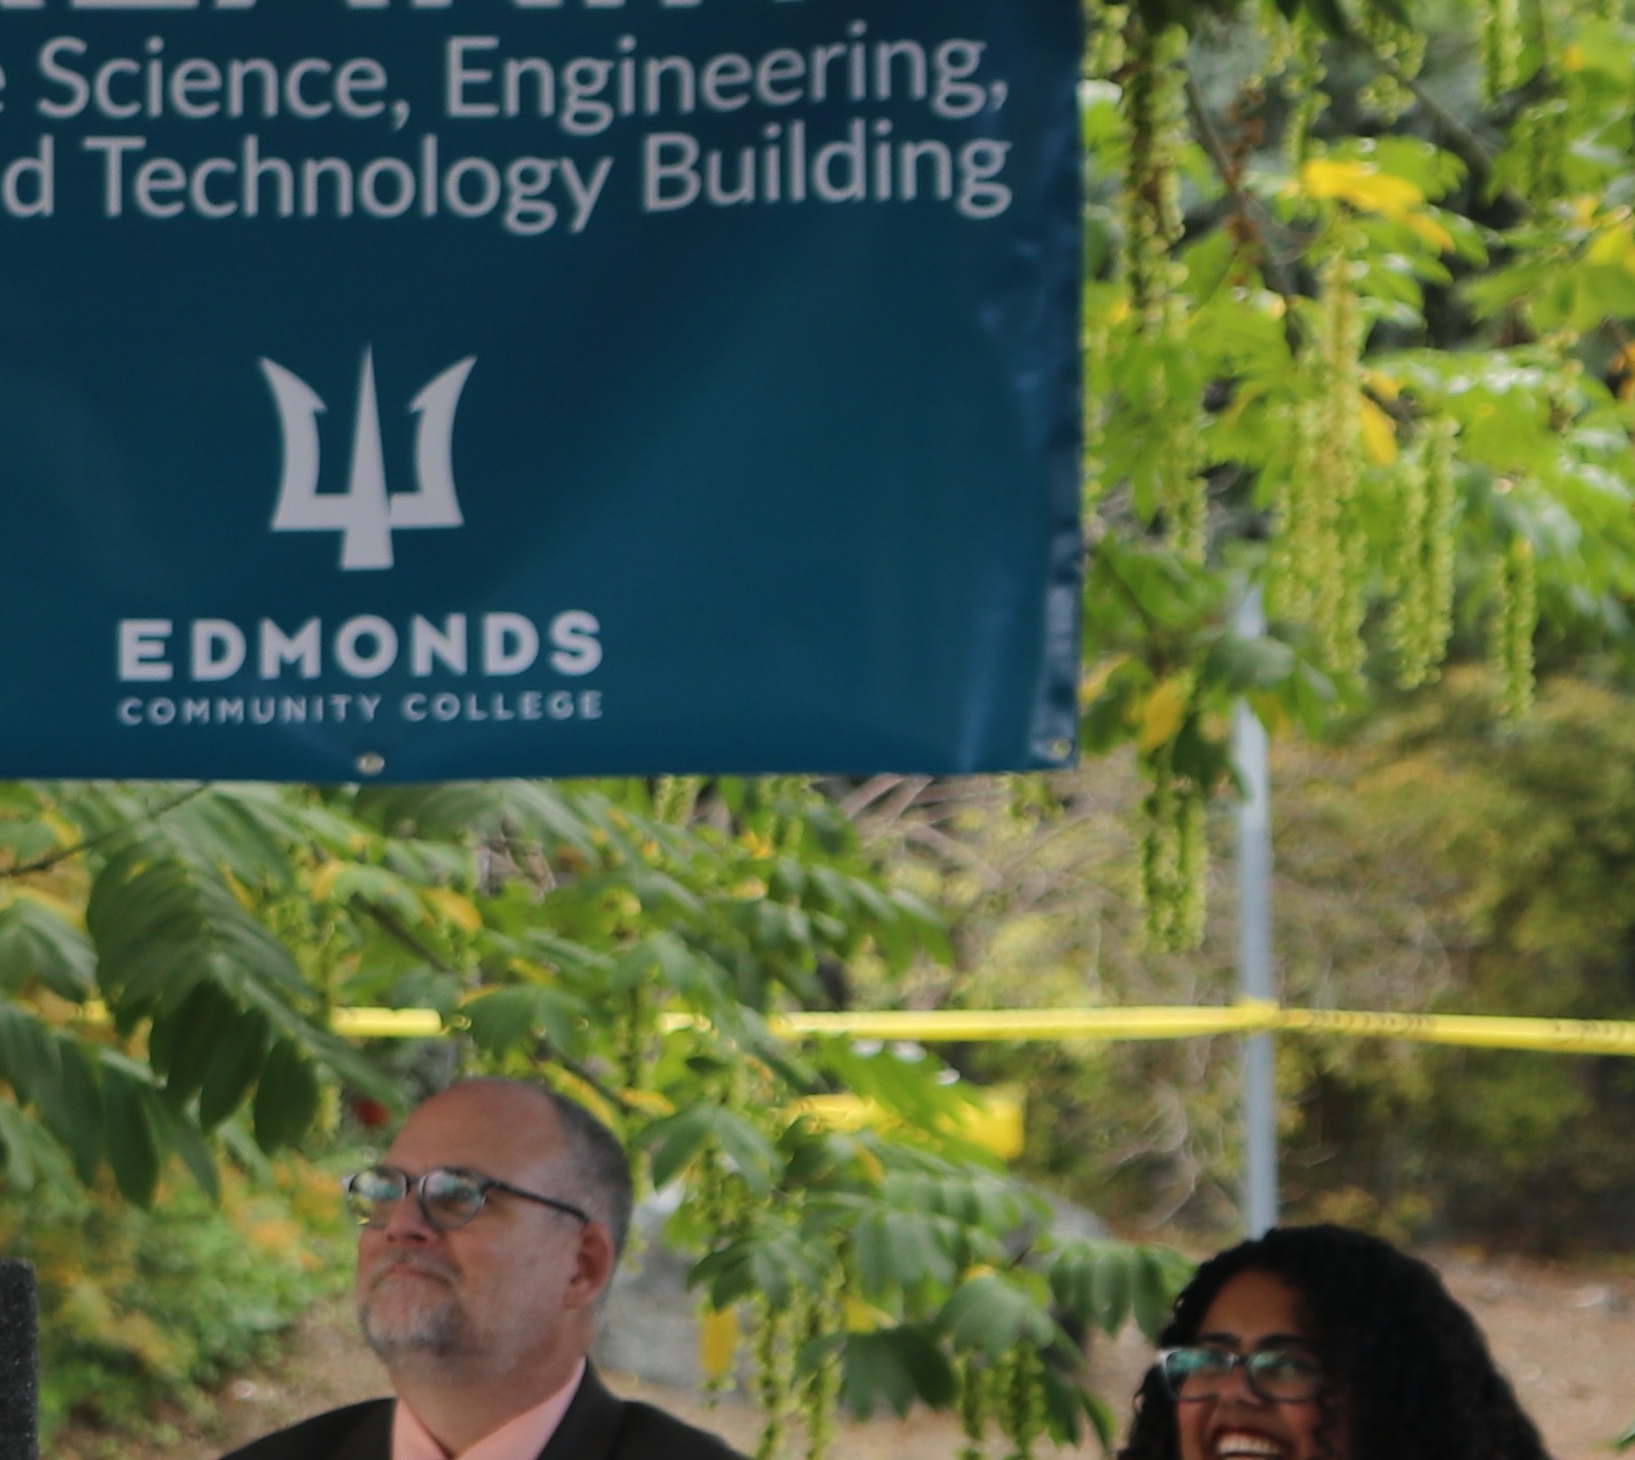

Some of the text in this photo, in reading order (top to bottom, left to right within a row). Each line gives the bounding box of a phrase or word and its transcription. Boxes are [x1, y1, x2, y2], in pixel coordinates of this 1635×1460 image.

[36, 35, 411, 130] Science,
[445, 20, 1009, 141] Engineering,
[81, 124, 614, 235] Technology
[642, 111, 1013, 219] Building
[117, 610, 603, 682] EDMONDS
[117, 690, 603, 725] COMMUNITY COLLEGE
